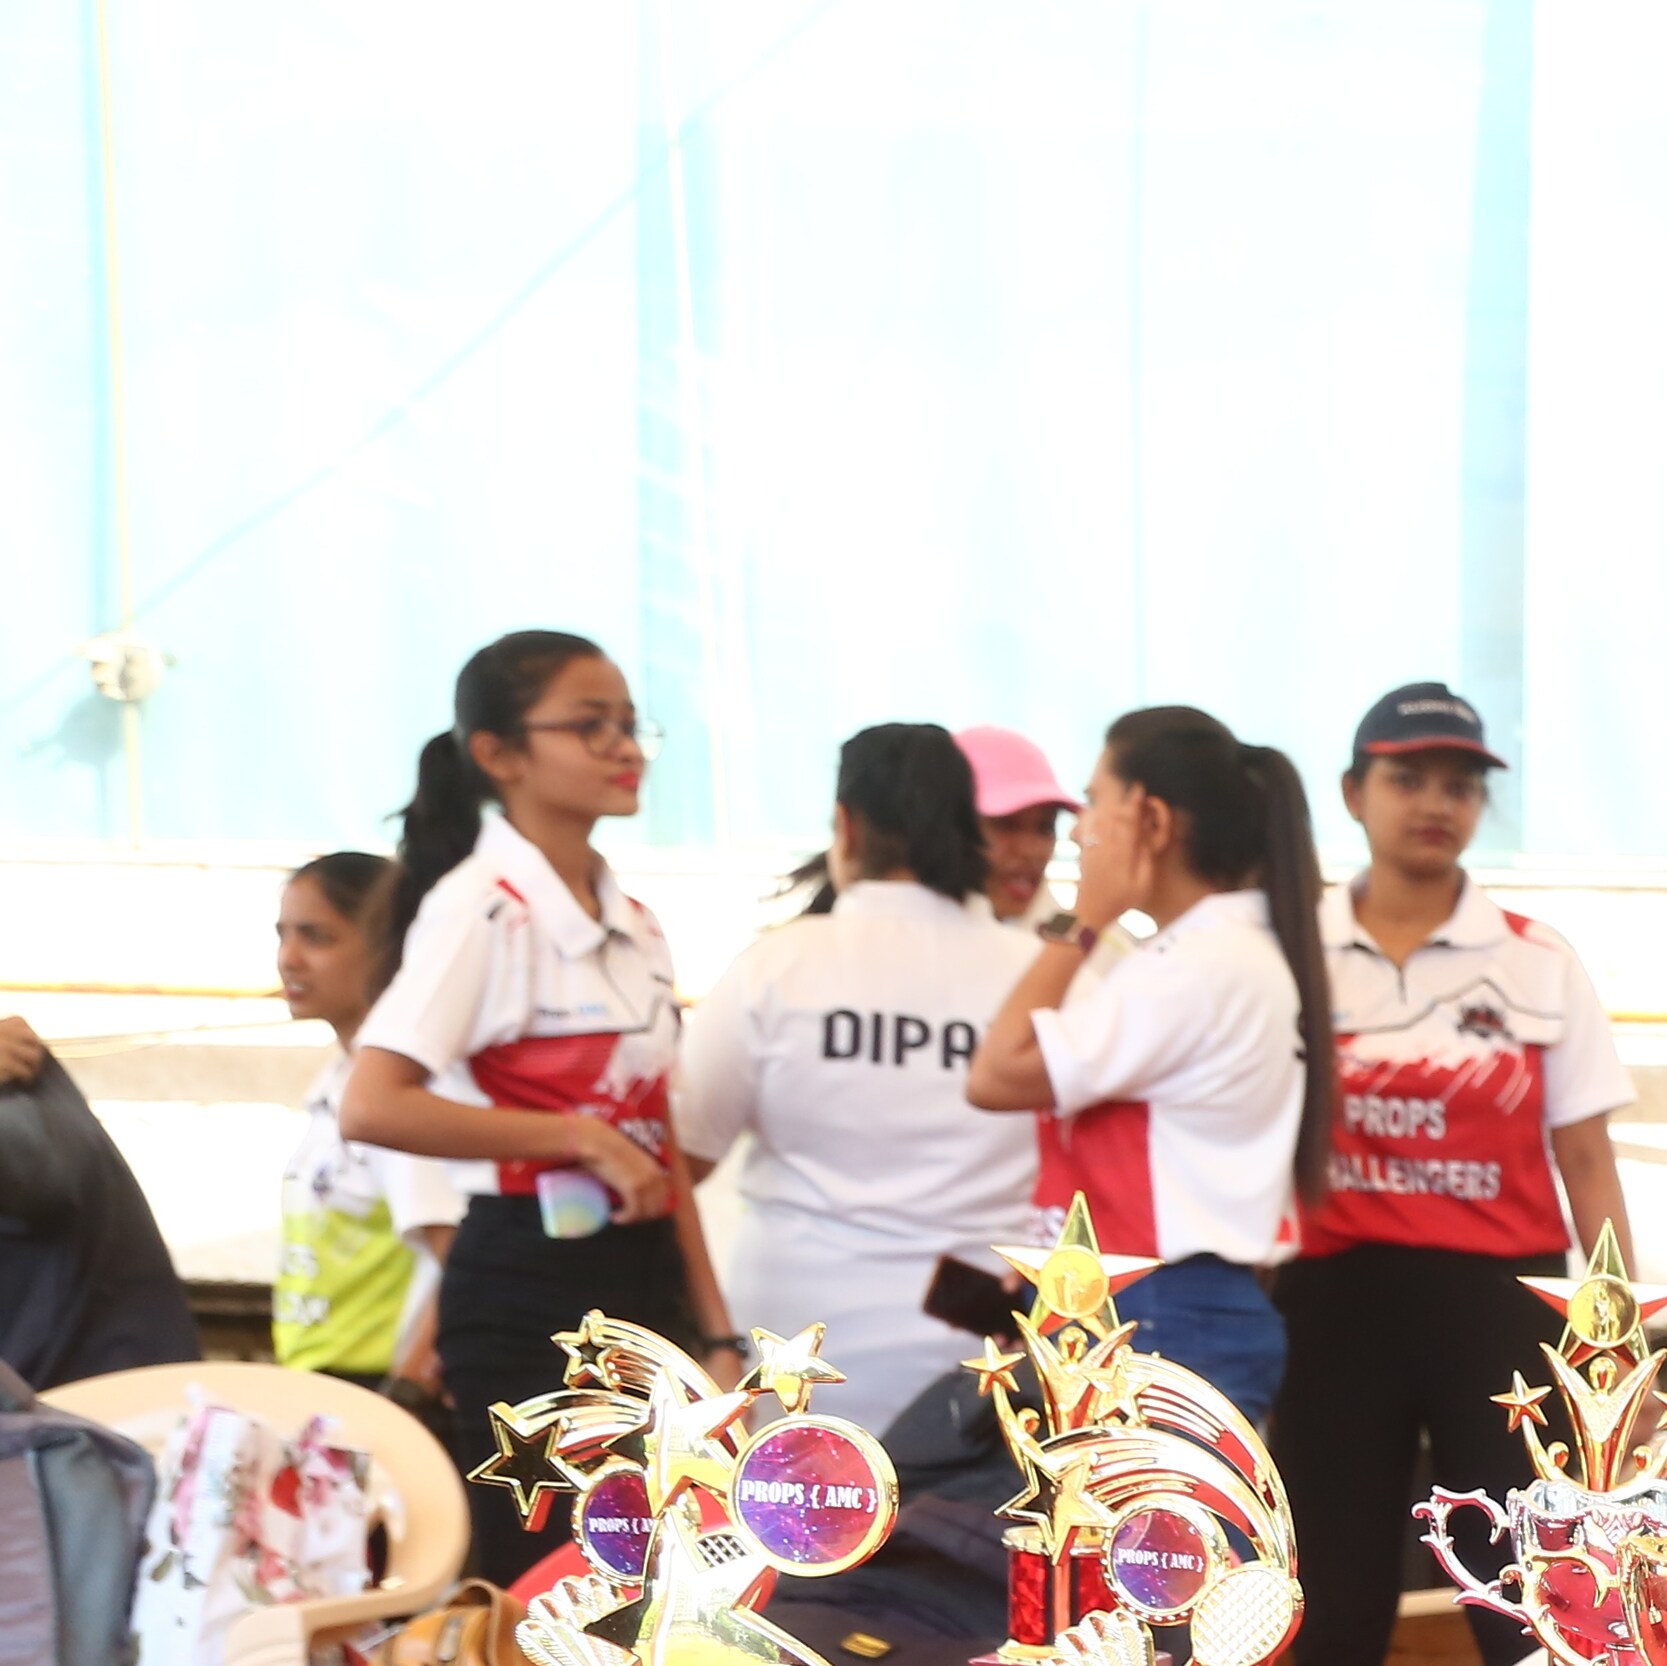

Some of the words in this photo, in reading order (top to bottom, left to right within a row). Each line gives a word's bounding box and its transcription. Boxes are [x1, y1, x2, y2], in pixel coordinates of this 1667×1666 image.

[1344, 1094, 1446, 1140] PROPS
[740, 1479, 804, 1507] PROPS
[824, 1484, 864, 1509] AMC
[588, 1517, 630, 1533] PROPS
[1117, 1547, 1159, 1566] PROPS
[1170, 1553, 1195, 1570] AMC
